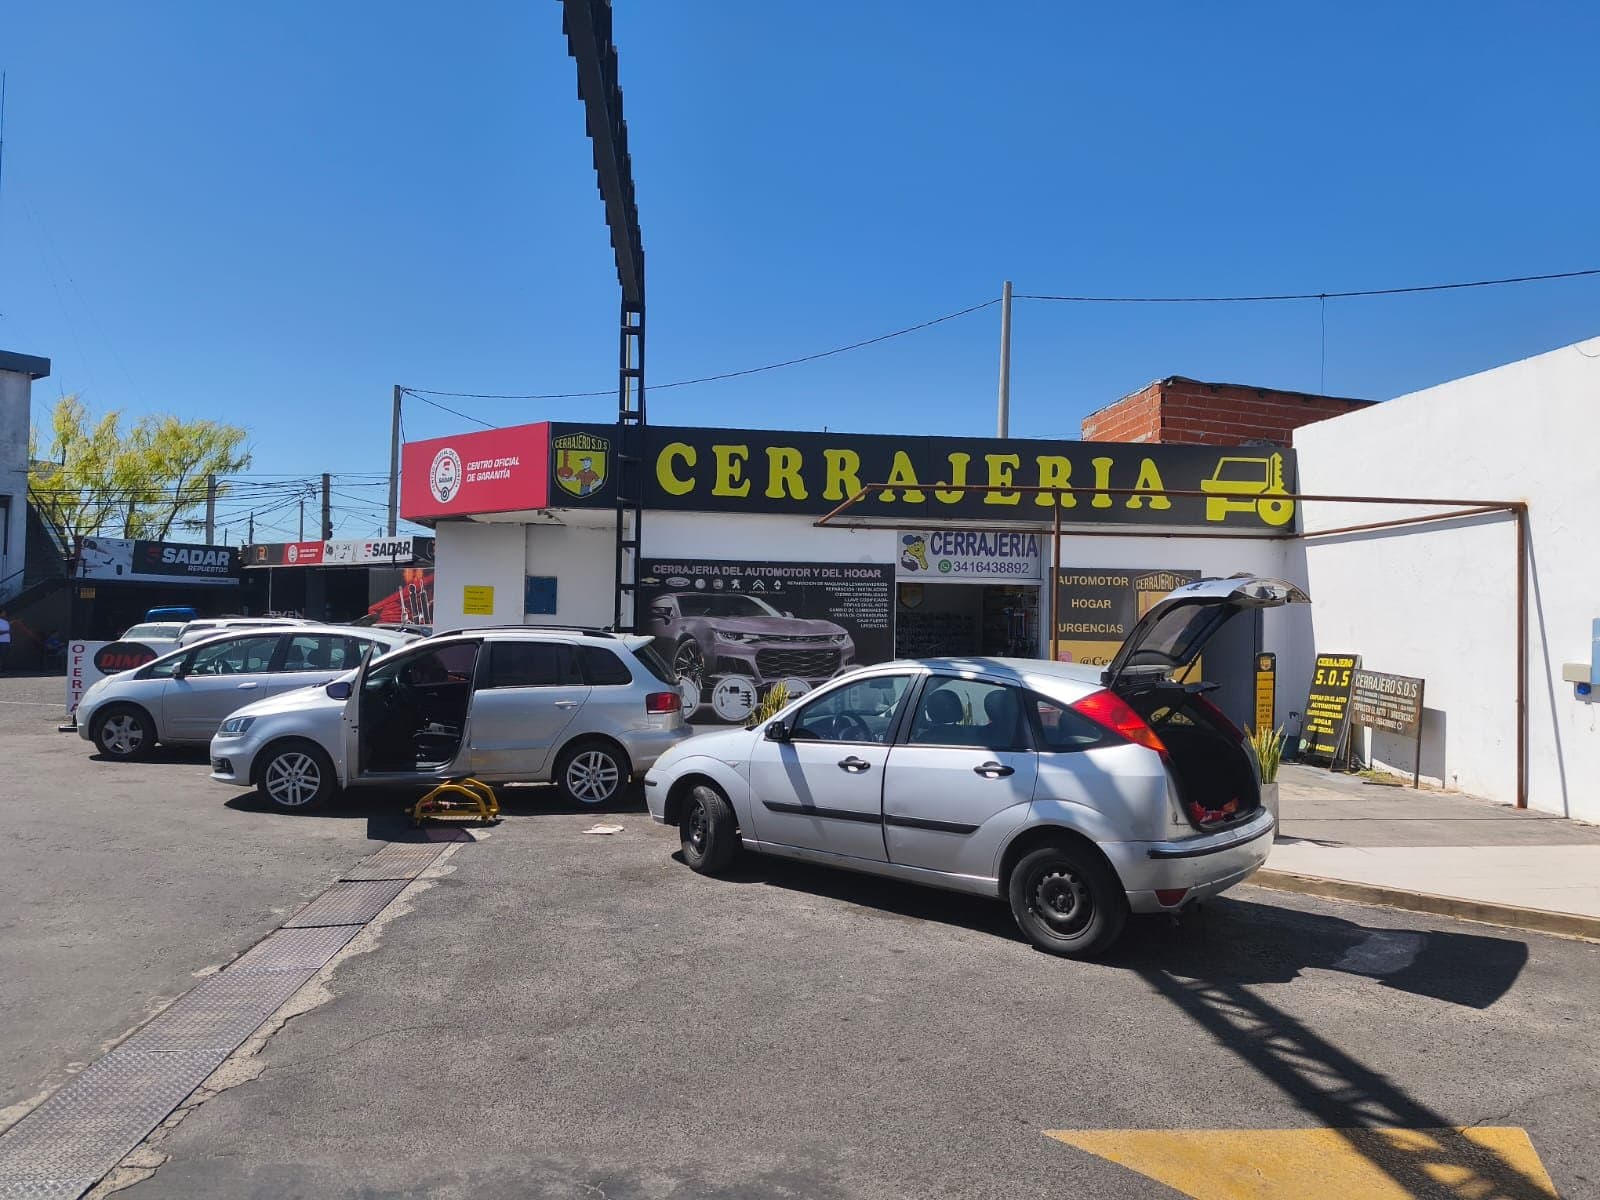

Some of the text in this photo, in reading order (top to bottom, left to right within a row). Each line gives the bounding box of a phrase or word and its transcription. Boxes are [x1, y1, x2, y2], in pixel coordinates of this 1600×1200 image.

[555, 434, 591, 449] CERRAJERO
[467, 457, 520, 470] CENTRO OFICIAL
[467, 468, 511, 482] DE GARANTÍA
[656, 442, 1172, 510] CERRAJERIA
[372, 541, 411, 557] SADAR
[930, 532, 1038, 558] CERRAJERIA
[162, 548, 231, 566] SADAR
[187, 565, 229, 573] REPUESTOS
[653, 564, 882, 579] CERRAJERIA DEL AUTOMOTOR Y DEL HOGAR
[953, 560, 1030, 574] 3416438892
[1058, 576, 1129, 586] AUTOMOTOR
[1136, 573, 1174, 590] CERRAJERO
[1071, 598, 1112, 609] HOGAR
[1058, 623, 1124, 634] URGENCIAS
[1080, 656, 1113, 666] @Ce
[1317, 657, 1354, 668] CERRAJERO
[1315, 669, 1351, 687] S.O.S
[1355, 673, 1396, 694] CERRAJERO
[1397, 680, 1418, 698] S.O.S
